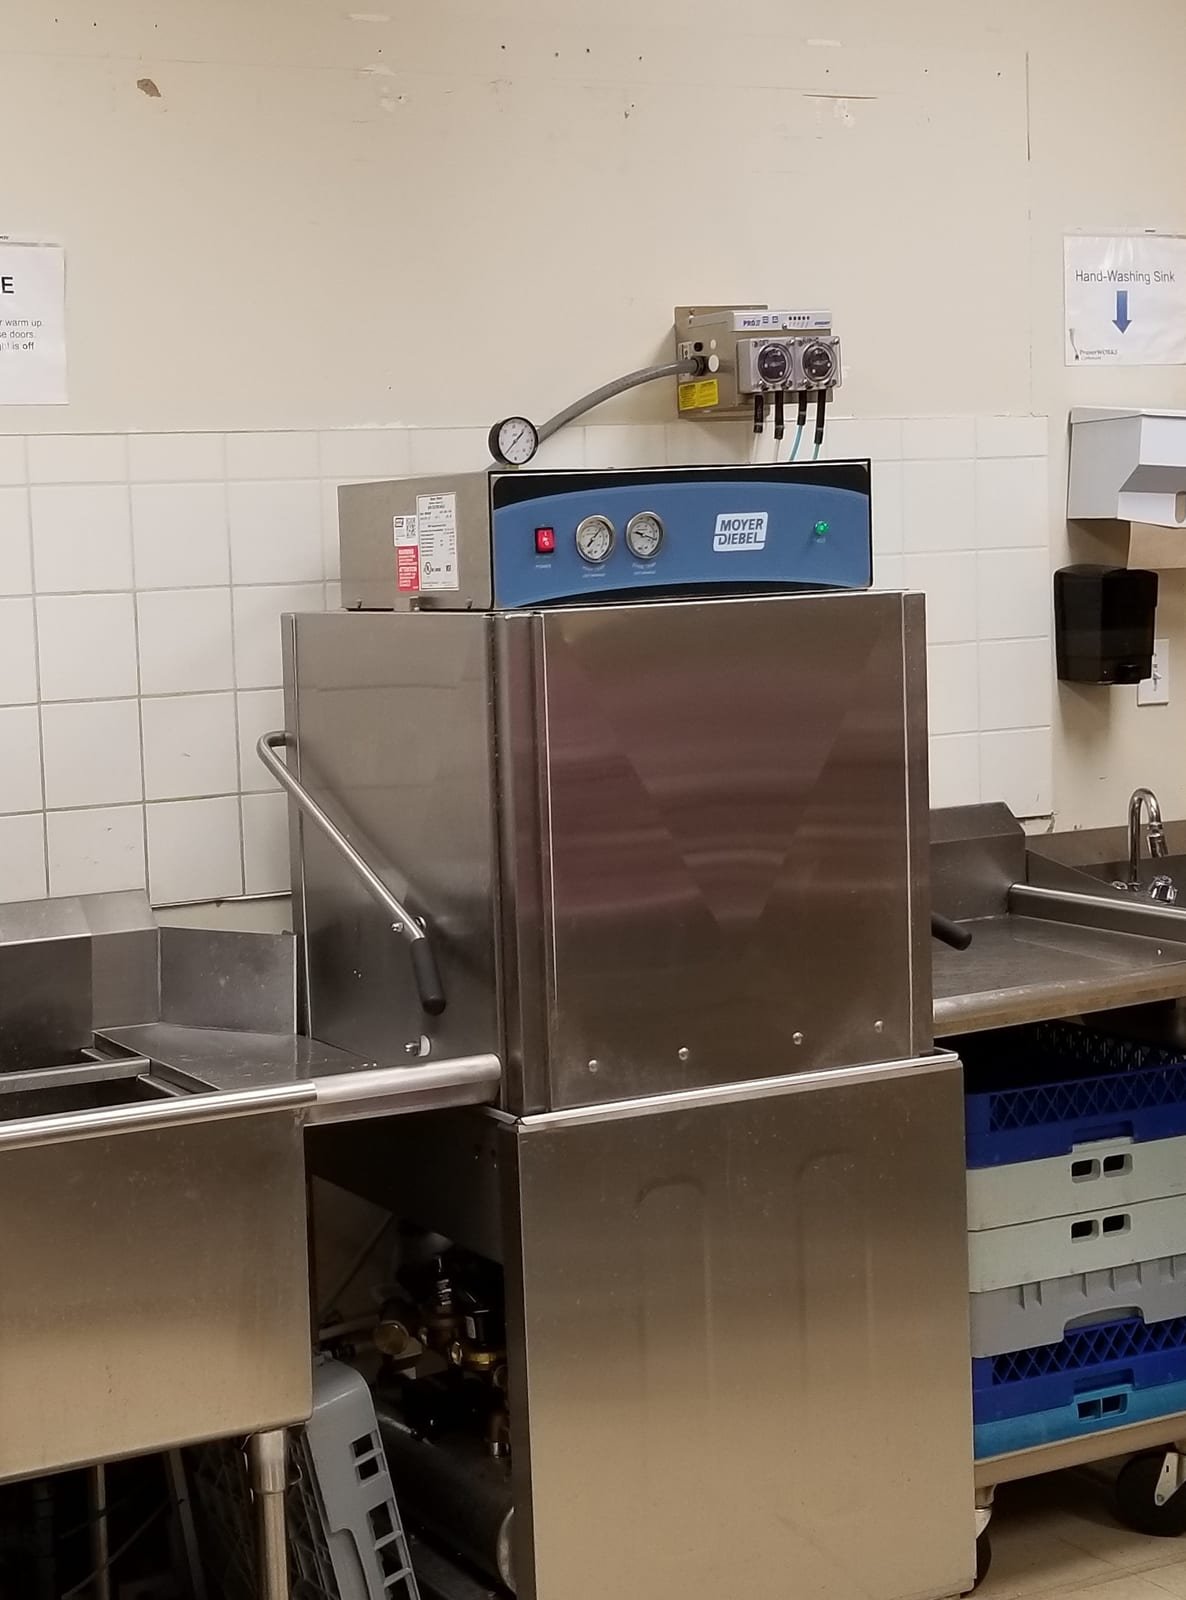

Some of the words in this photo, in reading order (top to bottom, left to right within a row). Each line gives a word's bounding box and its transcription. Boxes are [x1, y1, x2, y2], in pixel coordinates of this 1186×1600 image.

[1075, 269, 1151, 285] Hand-Washing
[1153, 270, 1175, 282] Sink
[5, 319, 29, 328] warm
[22, 341, 34, 350] off
[720, 518, 764, 532] MOYER
[714, 532, 766, 546] DIEBEL
